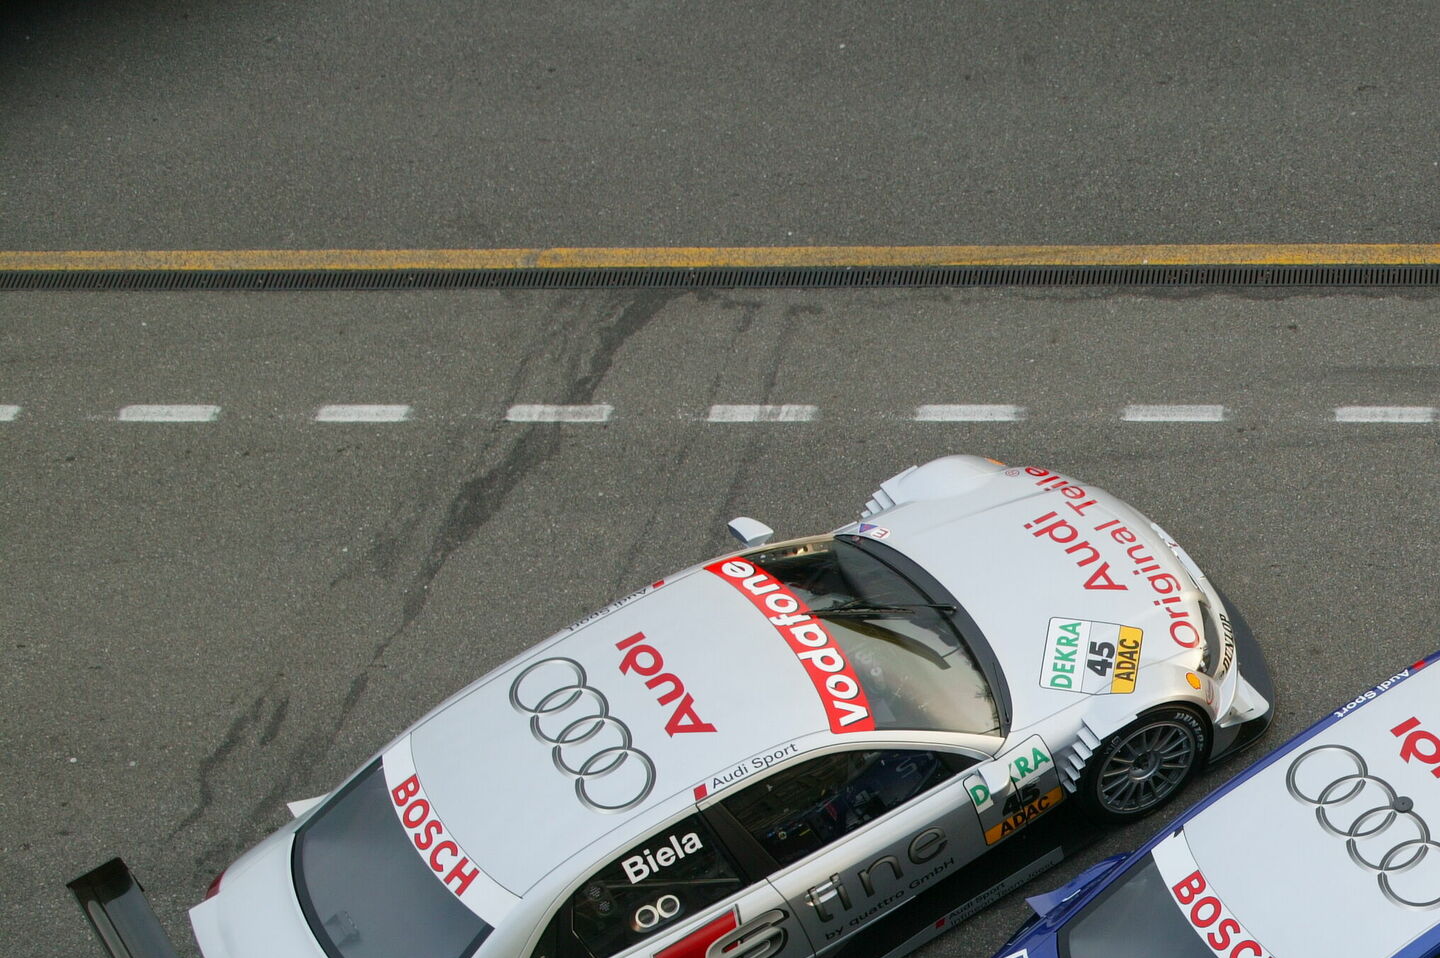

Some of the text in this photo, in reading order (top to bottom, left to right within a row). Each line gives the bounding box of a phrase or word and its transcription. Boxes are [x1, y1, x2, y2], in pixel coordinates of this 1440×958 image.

[1023, 511, 1128, 591] Audi
[1024, 466, 1201, 648] Original Teile
[721, 560, 869, 728] vodafone
[1049, 621, 1082, 689] DEKRA
[1086, 640, 1116, 677] 45
[1114, 637, 1142, 683] ADAC
[1219, 613, 1235, 672] DUNLOP
[615, 631, 718, 737] Audi
[1333, 668, 1410, 718] Audi Sport
[712, 742, 798, 789] Audi Sport
[970, 747, 1051, 806] DKRA
[391, 773, 480, 897] BOSCH
[1000, 796, 1051, 837] ADAC
[621, 832, 704, 884] Biela
[825, 857, 955, 941] by quattro GmbH
